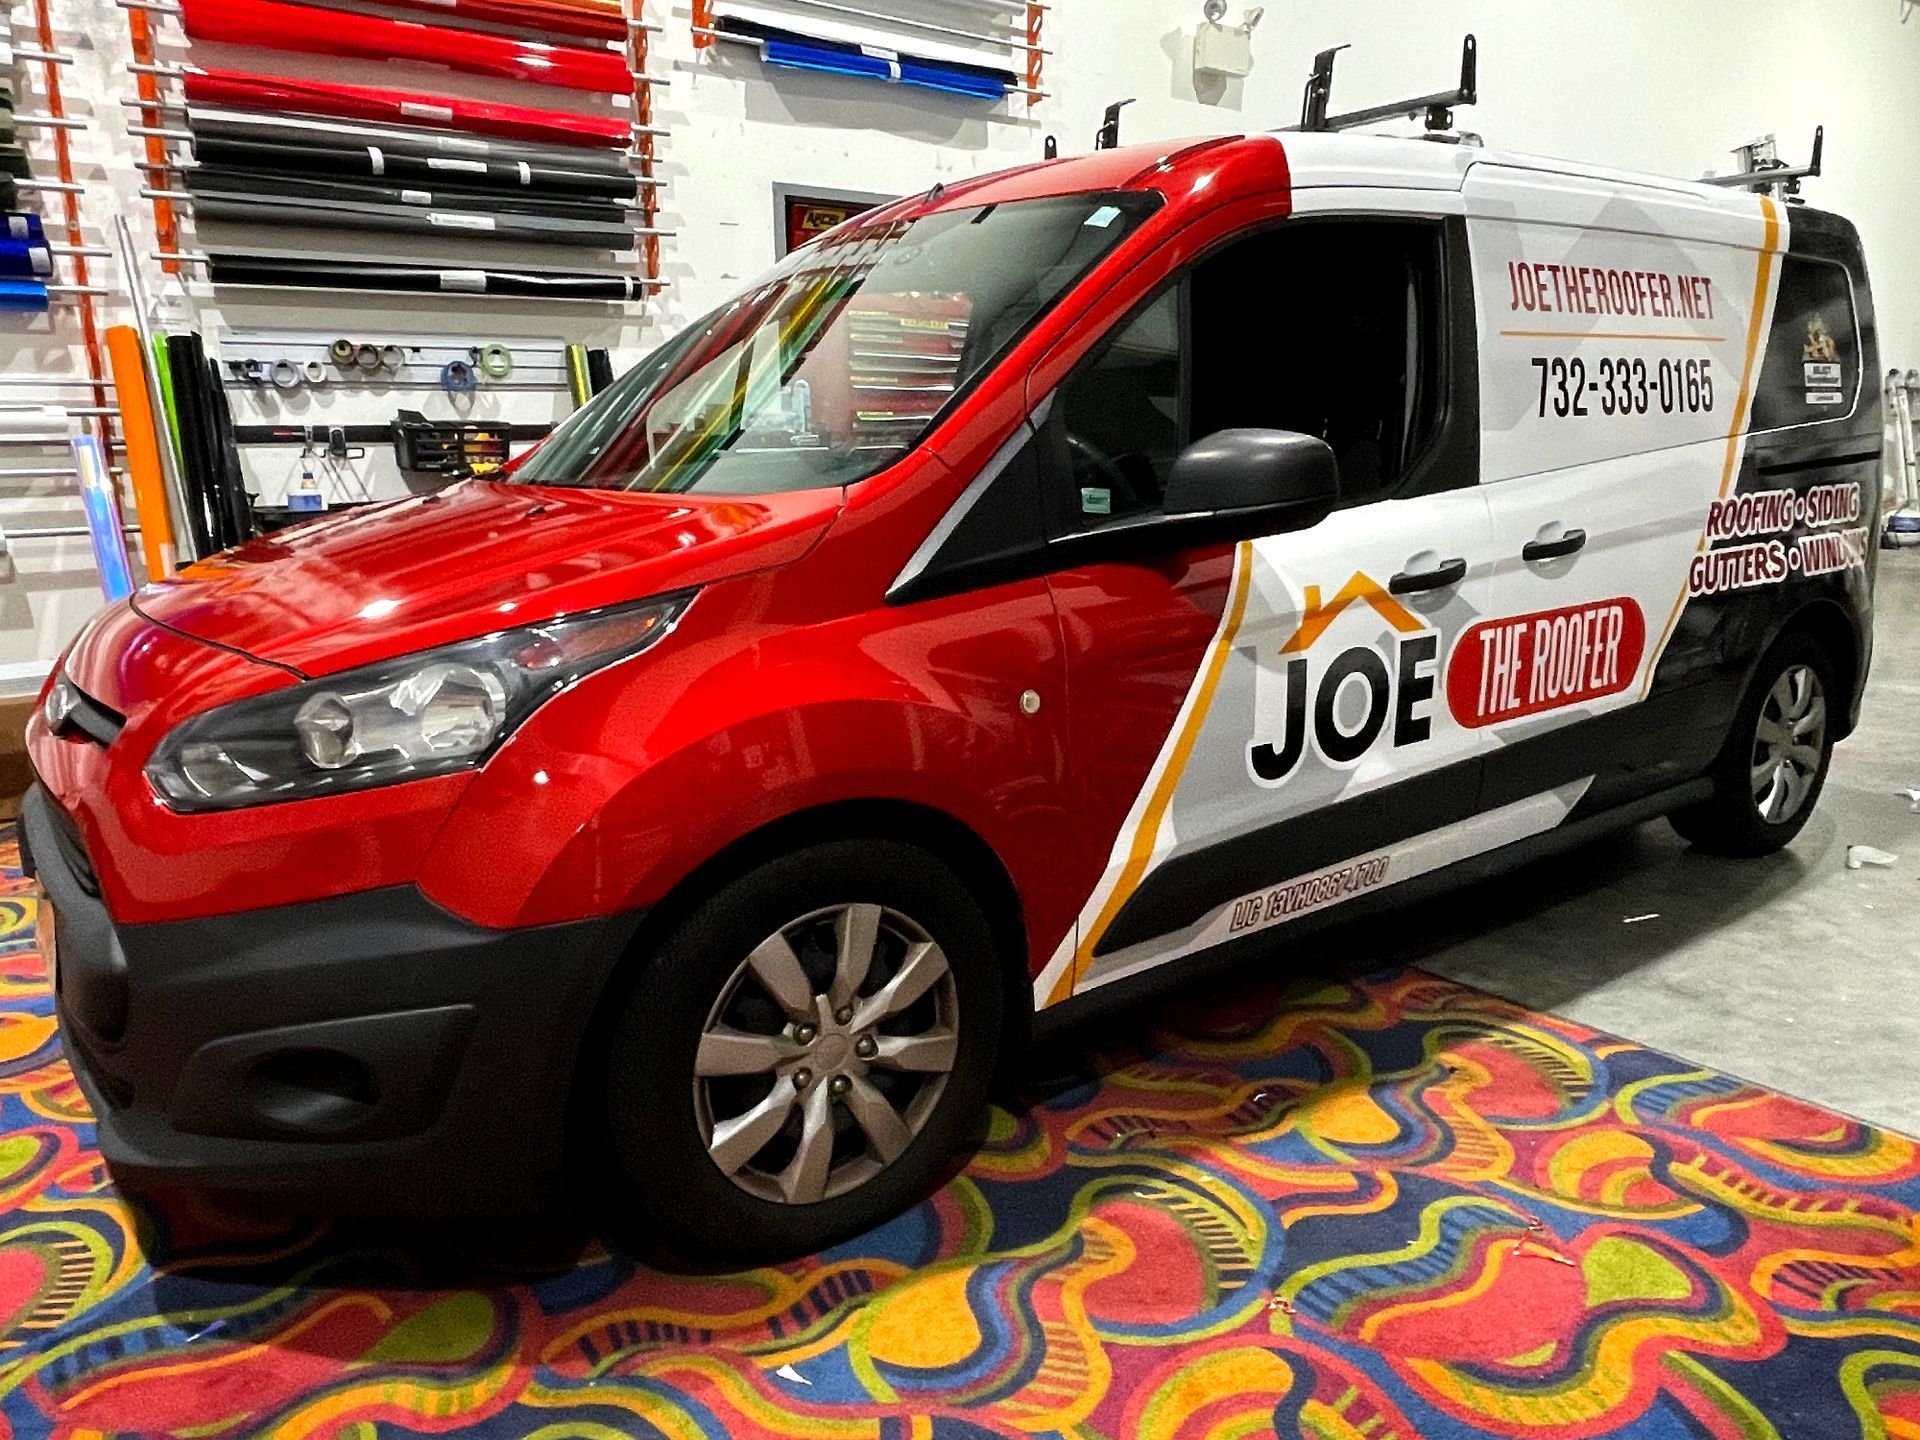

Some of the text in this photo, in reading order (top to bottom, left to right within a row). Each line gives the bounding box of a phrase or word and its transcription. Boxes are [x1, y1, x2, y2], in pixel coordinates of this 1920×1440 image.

[1508, 262, 1714, 320] JOETHEROOFER.NET
[1531, 357, 1714, 418] 732-333-0165
[1706, 486, 1860, 537] ROOFING SIDING
[1689, 544, 1786, 593] GUTTERS
[1477, 605, 1623, 717] THE ROOFER
[1251, 635, 1437, 781] JOE
[1229, 895, 1263, 933] LIC
